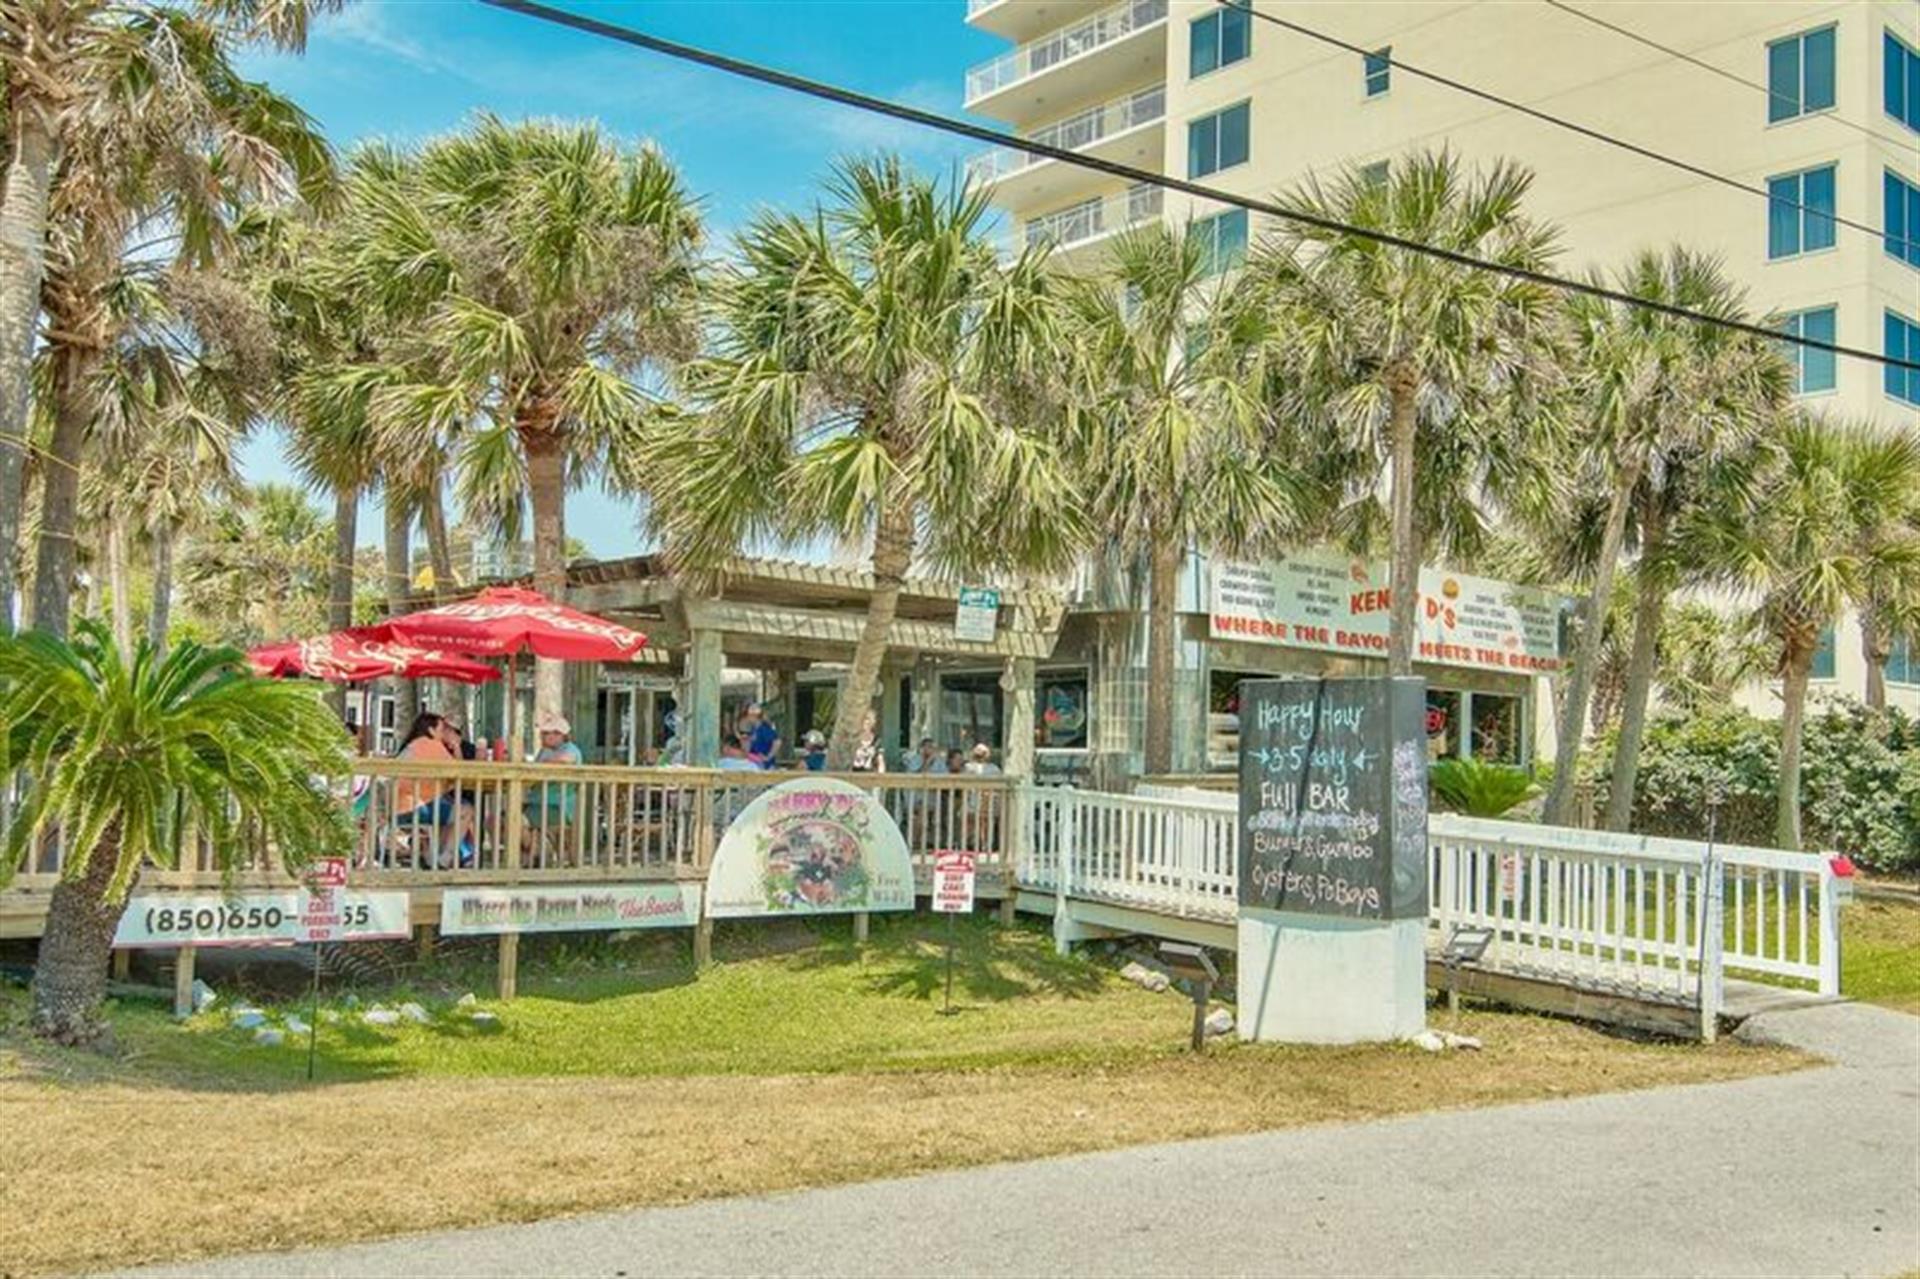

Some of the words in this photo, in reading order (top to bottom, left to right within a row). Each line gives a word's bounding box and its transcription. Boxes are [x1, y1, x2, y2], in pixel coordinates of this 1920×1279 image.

[1214, 615, 1288, 640] WHERE
[1293, 624, 1331, 645] THE
[1419, 641, 1472, 661] MEETS
[1476, 648, 1505, 666] THE
[1509, 653, 1560, 671] BEACH
[1258, 699, 1314, 740] Happy
[1320, 695, 1365, 734] Hour
[1309, 782, 1351, 813] BAR
[647, 892, 683, 915] Beach
